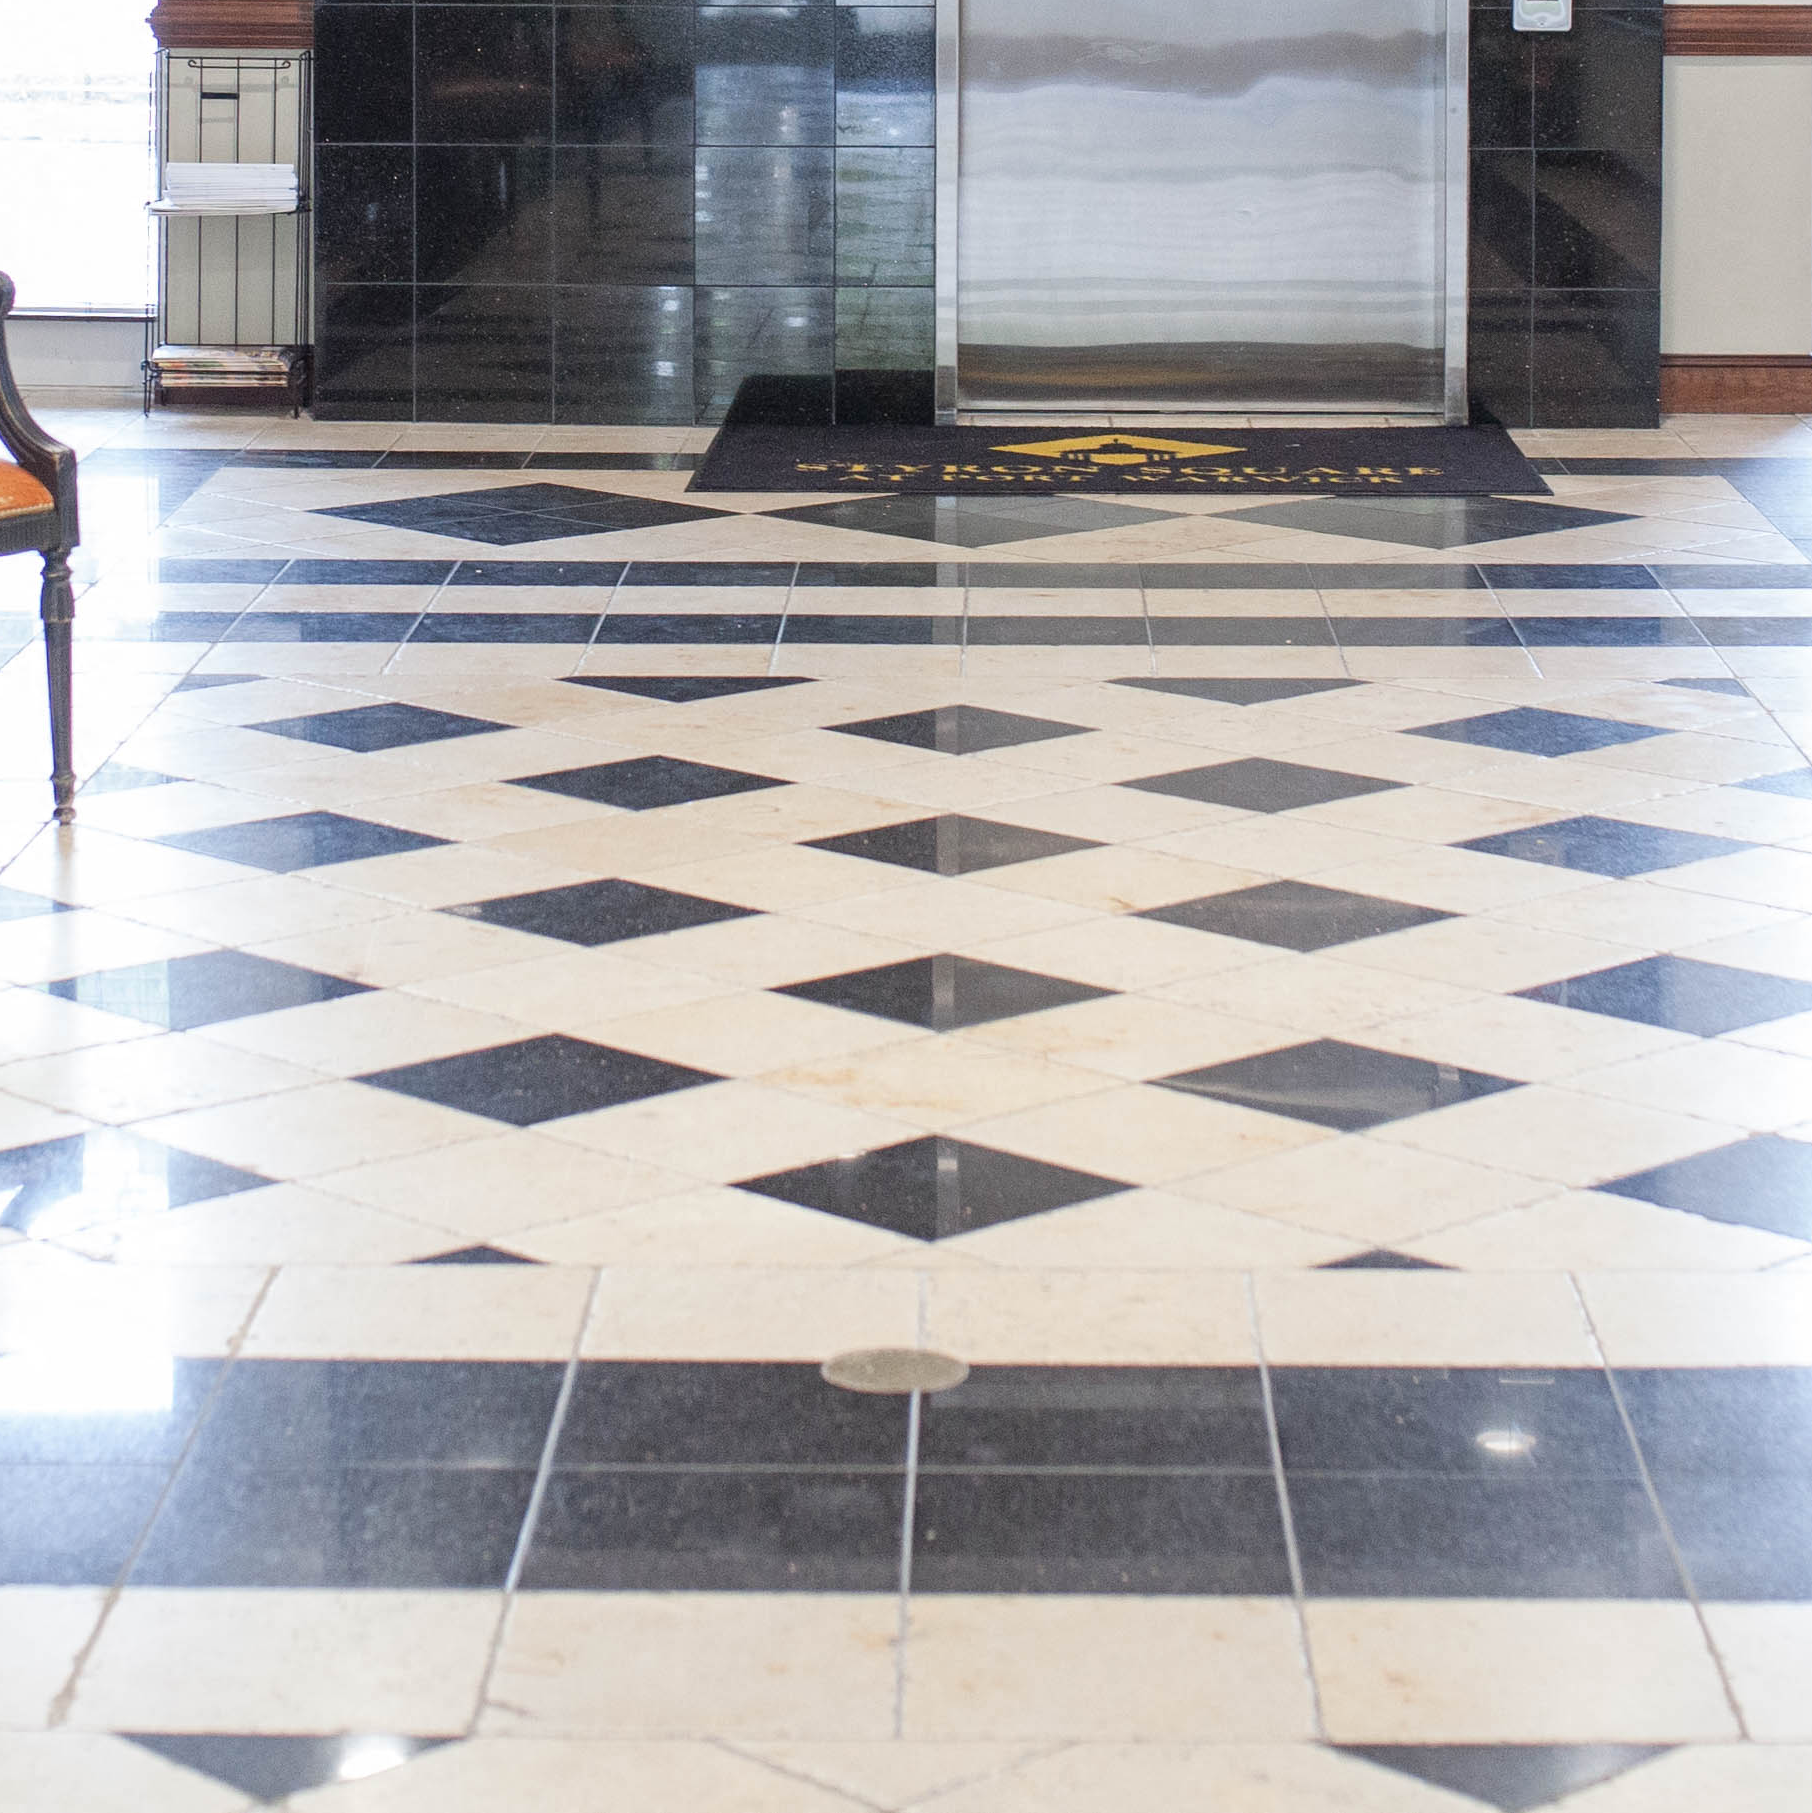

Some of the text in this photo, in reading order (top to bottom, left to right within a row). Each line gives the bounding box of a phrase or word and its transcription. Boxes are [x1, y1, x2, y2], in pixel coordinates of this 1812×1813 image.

[795, 462, 1444, 476] STYRON SQUARE
[1121, 474, 1404, 484] WARWICK
